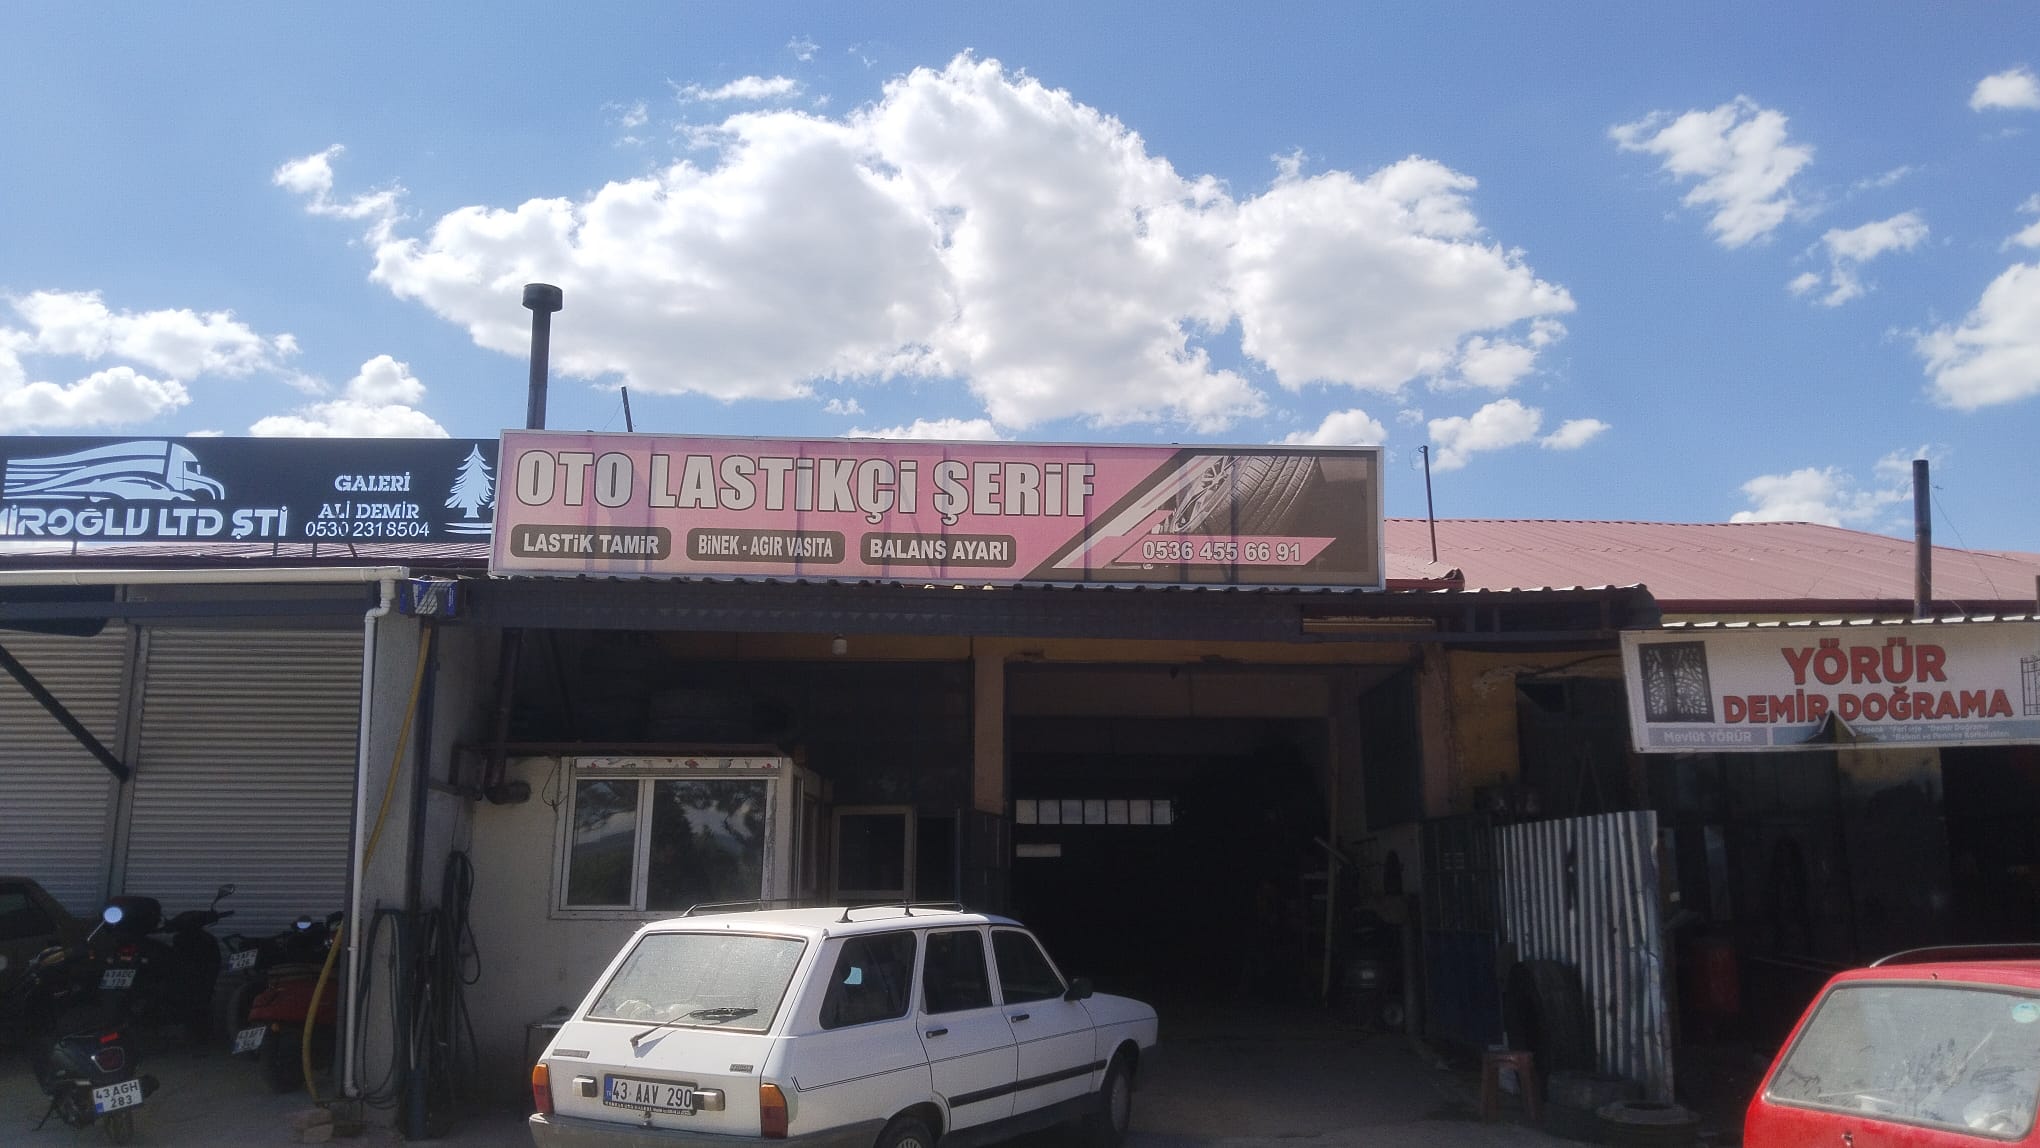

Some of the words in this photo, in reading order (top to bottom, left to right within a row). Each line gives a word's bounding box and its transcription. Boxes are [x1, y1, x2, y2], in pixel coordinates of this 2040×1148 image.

[334, 471, 411, 492] GALERİ
[516, 450, 634, 507] OTO
[317, 500, 351, 519] ALİ
[355, 500, 420, 519] DEMİR
[157, 508, 224, 536] LTD
[230, 505, 289, 540] ŞTİ
[305, 521, 349, 537] 0530
[786, 537, 833, 558] VASITA
[870, 538, 947, 560] BALANS
[951, 540, 1008, 561] AYARI
[1142, 541, 1194, 560] 0536
[1199, 541, 1238, 561] 455
[1244, 542, 1270, 562] 66
[1276, 542, 1300, 562] 91
[1781, 636, 1948, 686] YÖRÜR
[1723, 689, 1831, 724] DEMİR
[1838, 686, 2014, 722] DOĞRAMA
[1708, 729, 1753, 743] YÖRÜR
[111, 1095, 133, 1108] 283
[613, 1080, 628, 1101] 43
[635, 1083, 659, 1105] AAV
[666, 1087, 692, 1108] 290
